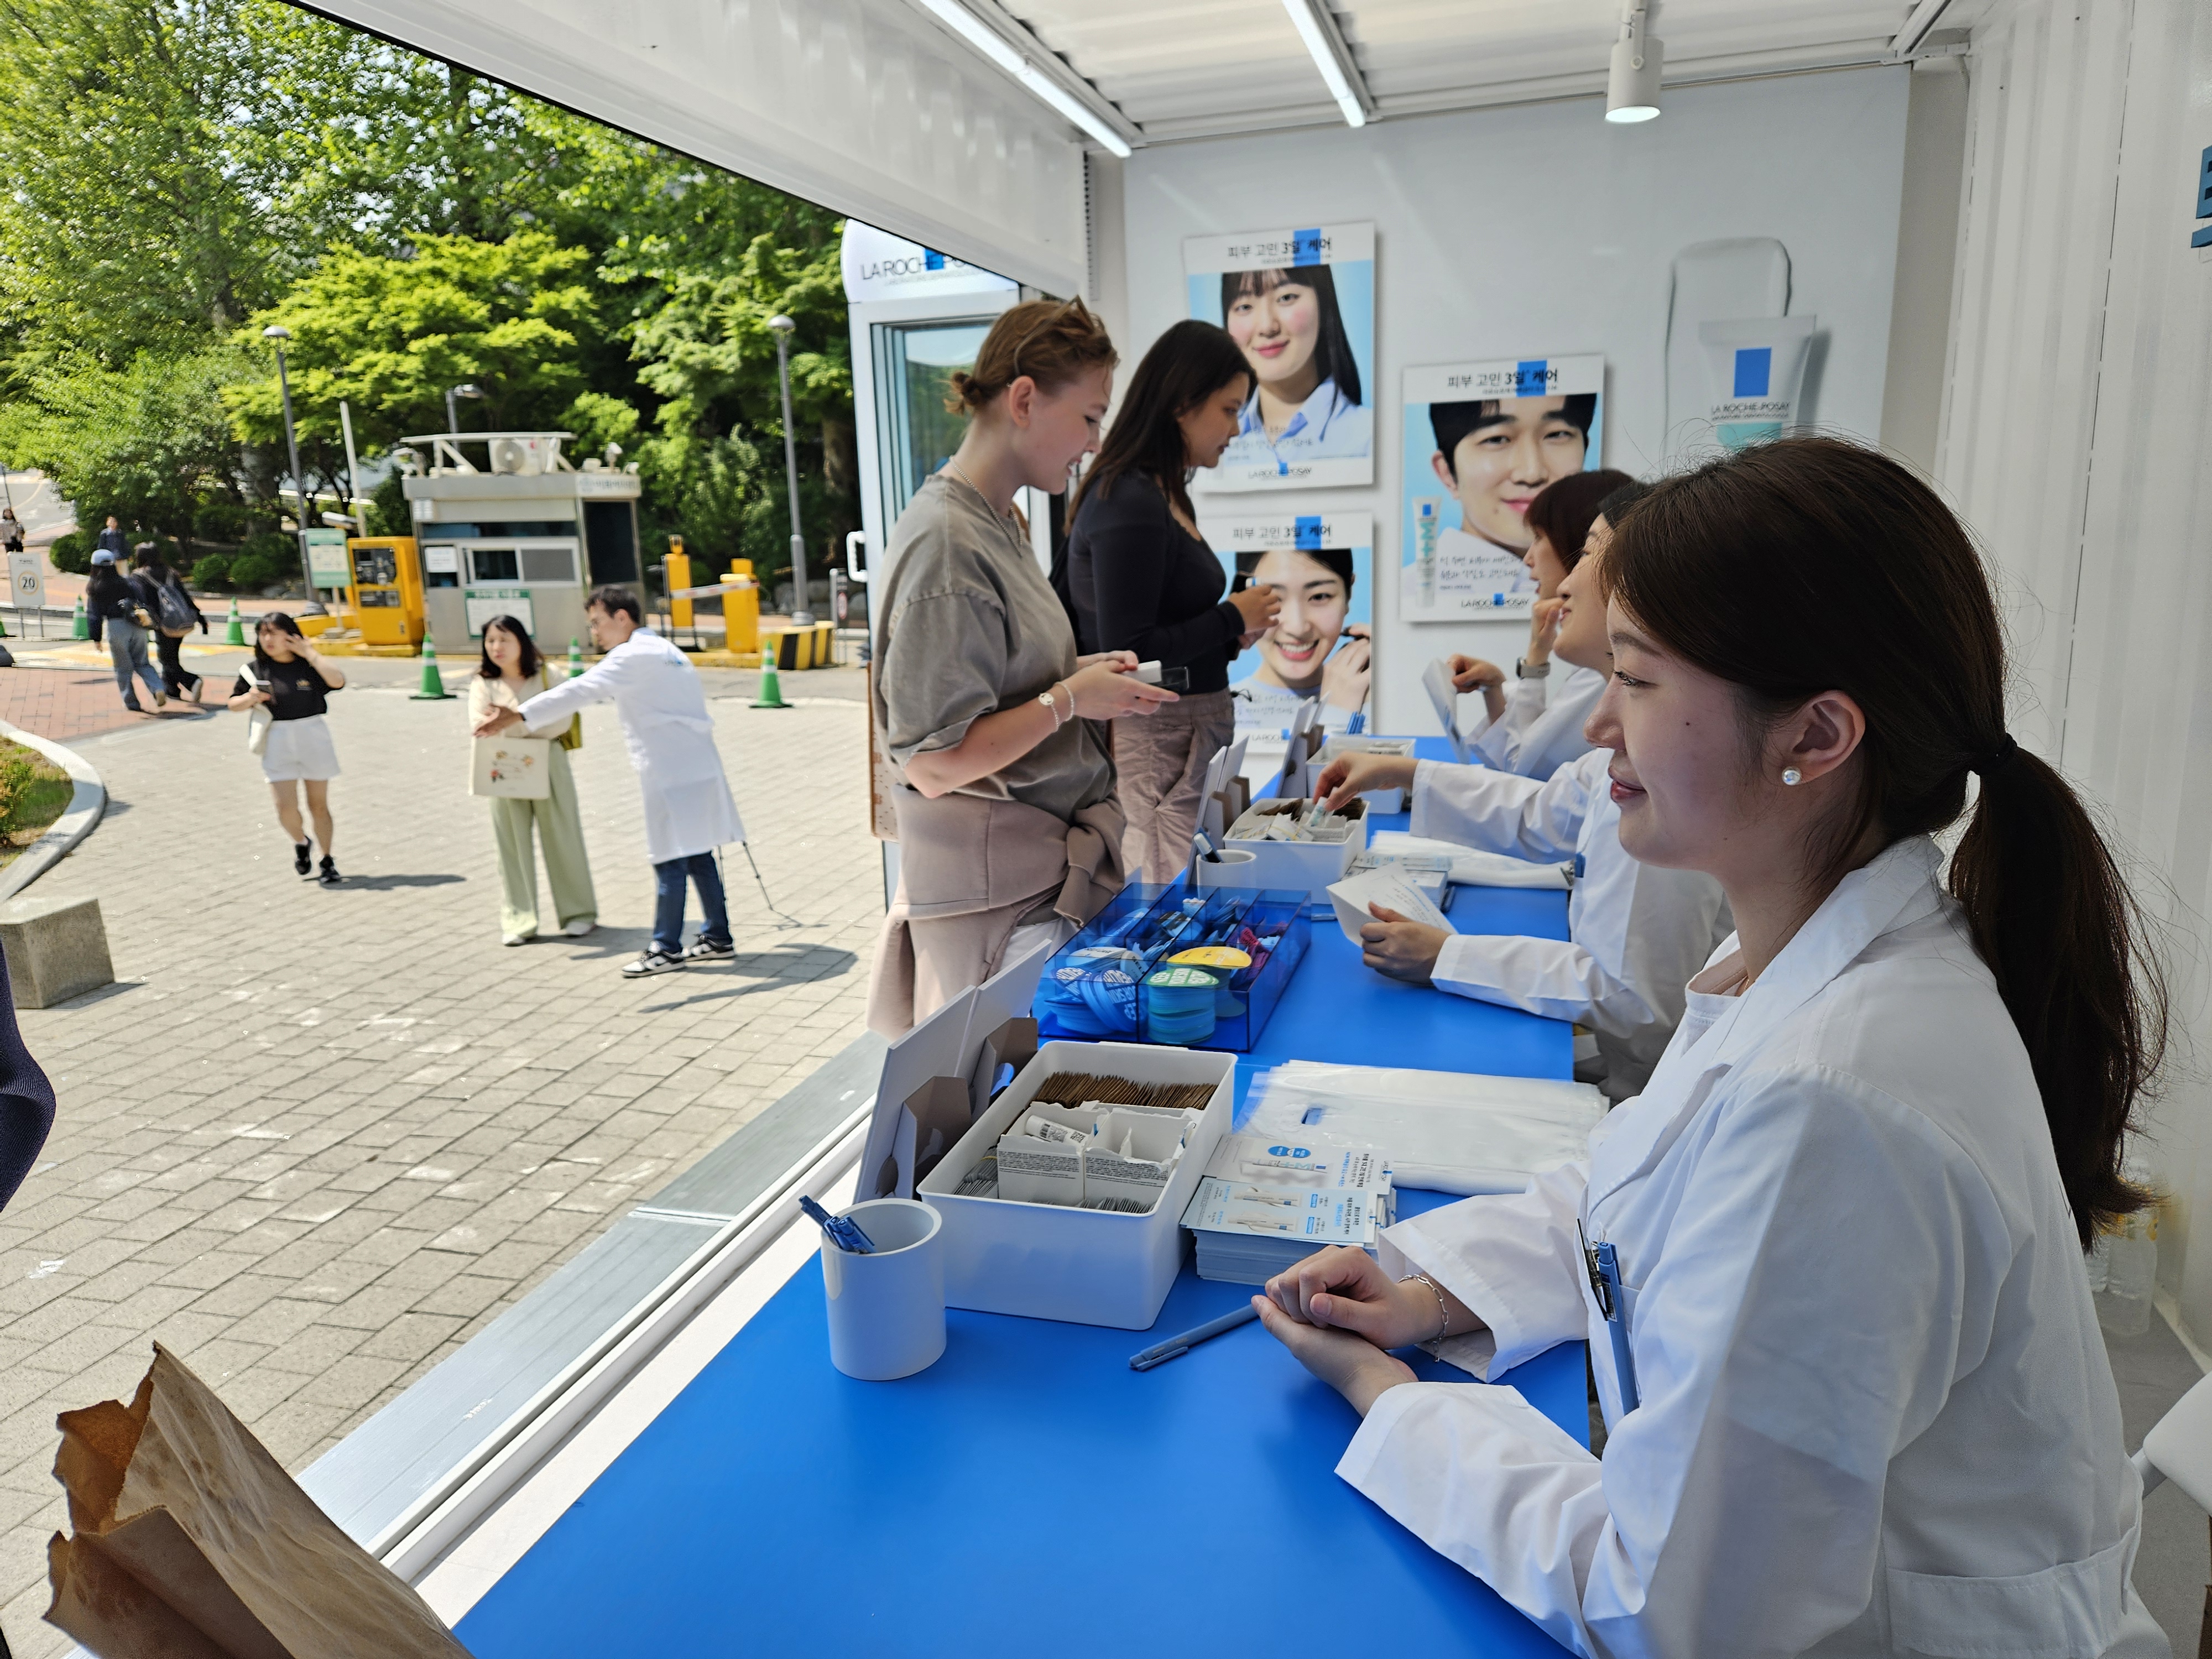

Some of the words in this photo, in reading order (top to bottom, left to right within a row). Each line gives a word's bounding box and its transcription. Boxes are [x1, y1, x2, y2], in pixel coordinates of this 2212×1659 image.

[1228, 244, 1251, 258] 피부
[1255, 243, 1279, 257] 고민
[1307, 237, 1333, 251] 케어
[860, 261, 880, 280] LA
[1447, 374, 1473, 388] 피부
[1477, 372, 1501, 387] 고민
[1532, 368, 1558, 382] 케어
[1233, 526, 1254, 539] 피부
[1259, 525, 1280, 538] 고민
[1308, 523, 1331, 537] 케어
[22, 576, 35, 590] 20
